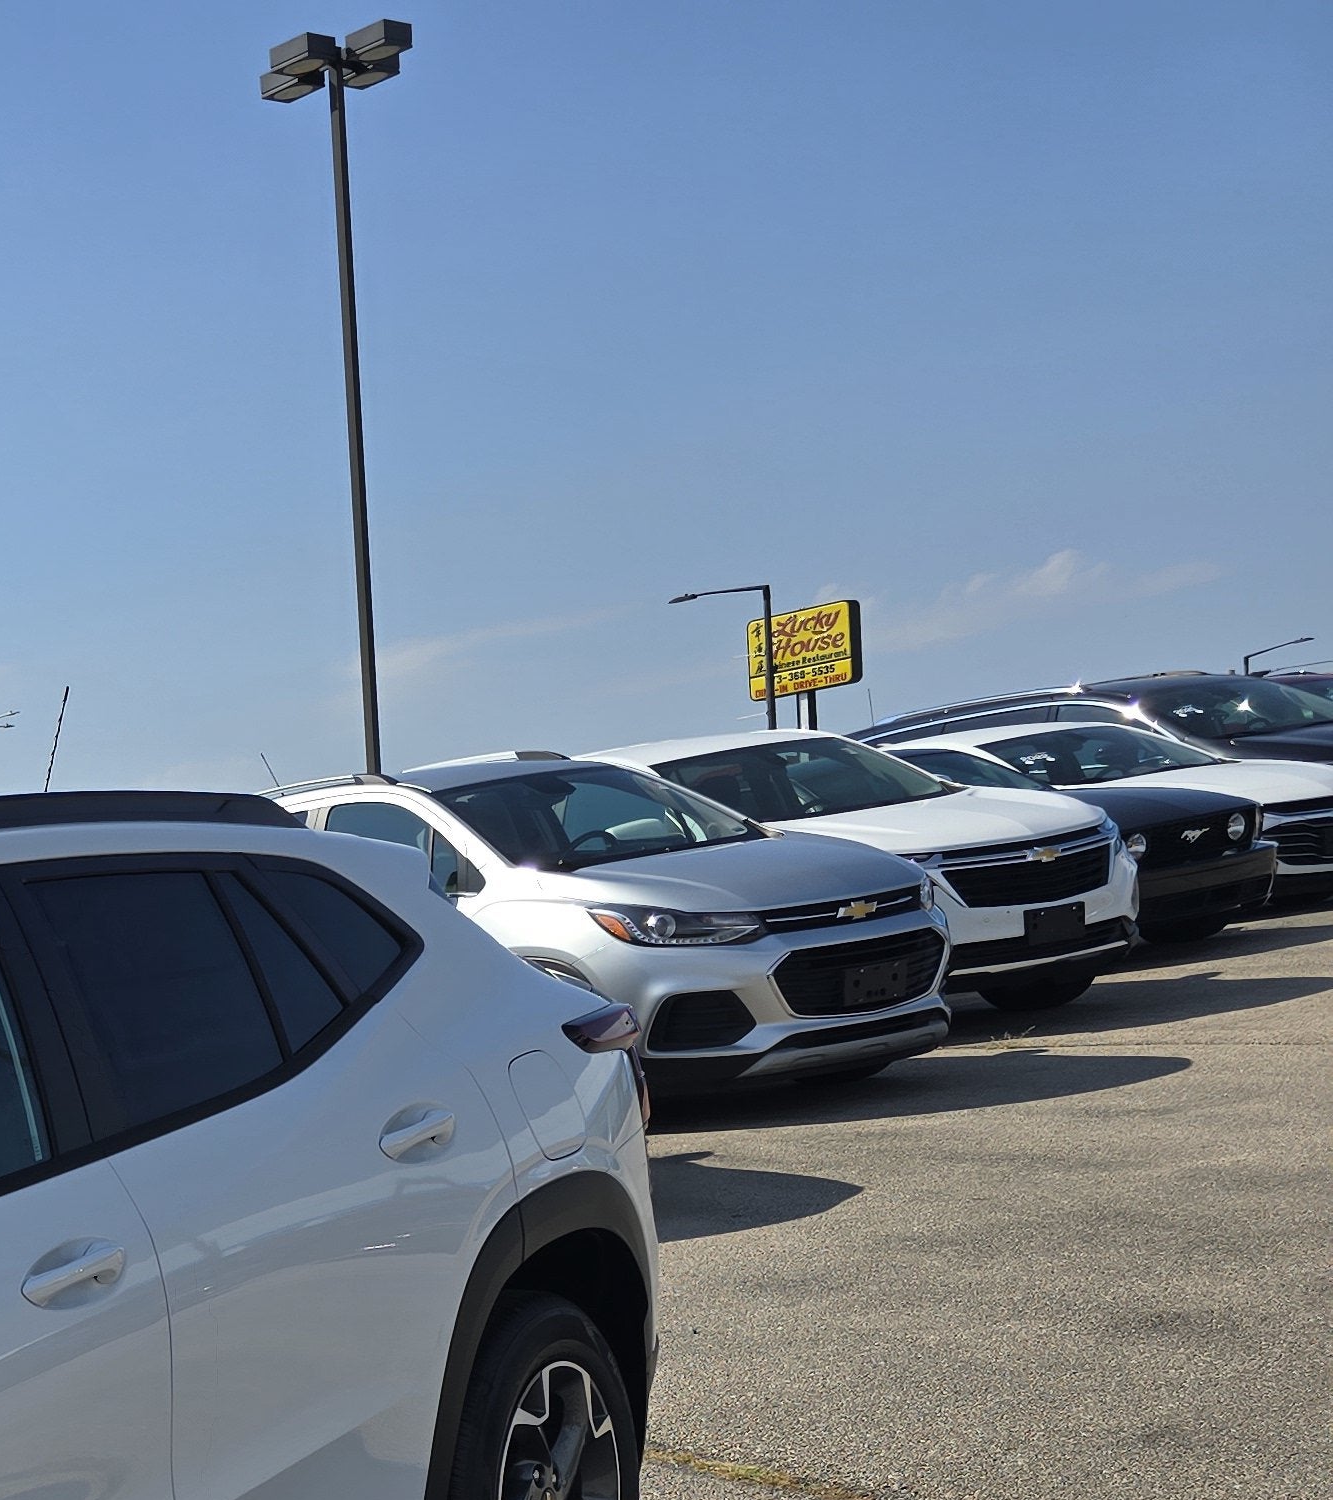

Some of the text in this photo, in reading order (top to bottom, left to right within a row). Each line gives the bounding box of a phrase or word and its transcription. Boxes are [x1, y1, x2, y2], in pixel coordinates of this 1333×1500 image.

[773, 609, 842, 638] Lucky
[773, 632, 845, 660] House
[801, 648, 847, 665] Restaurant
[793, 672, 847, 690] DRIVE-THRU
